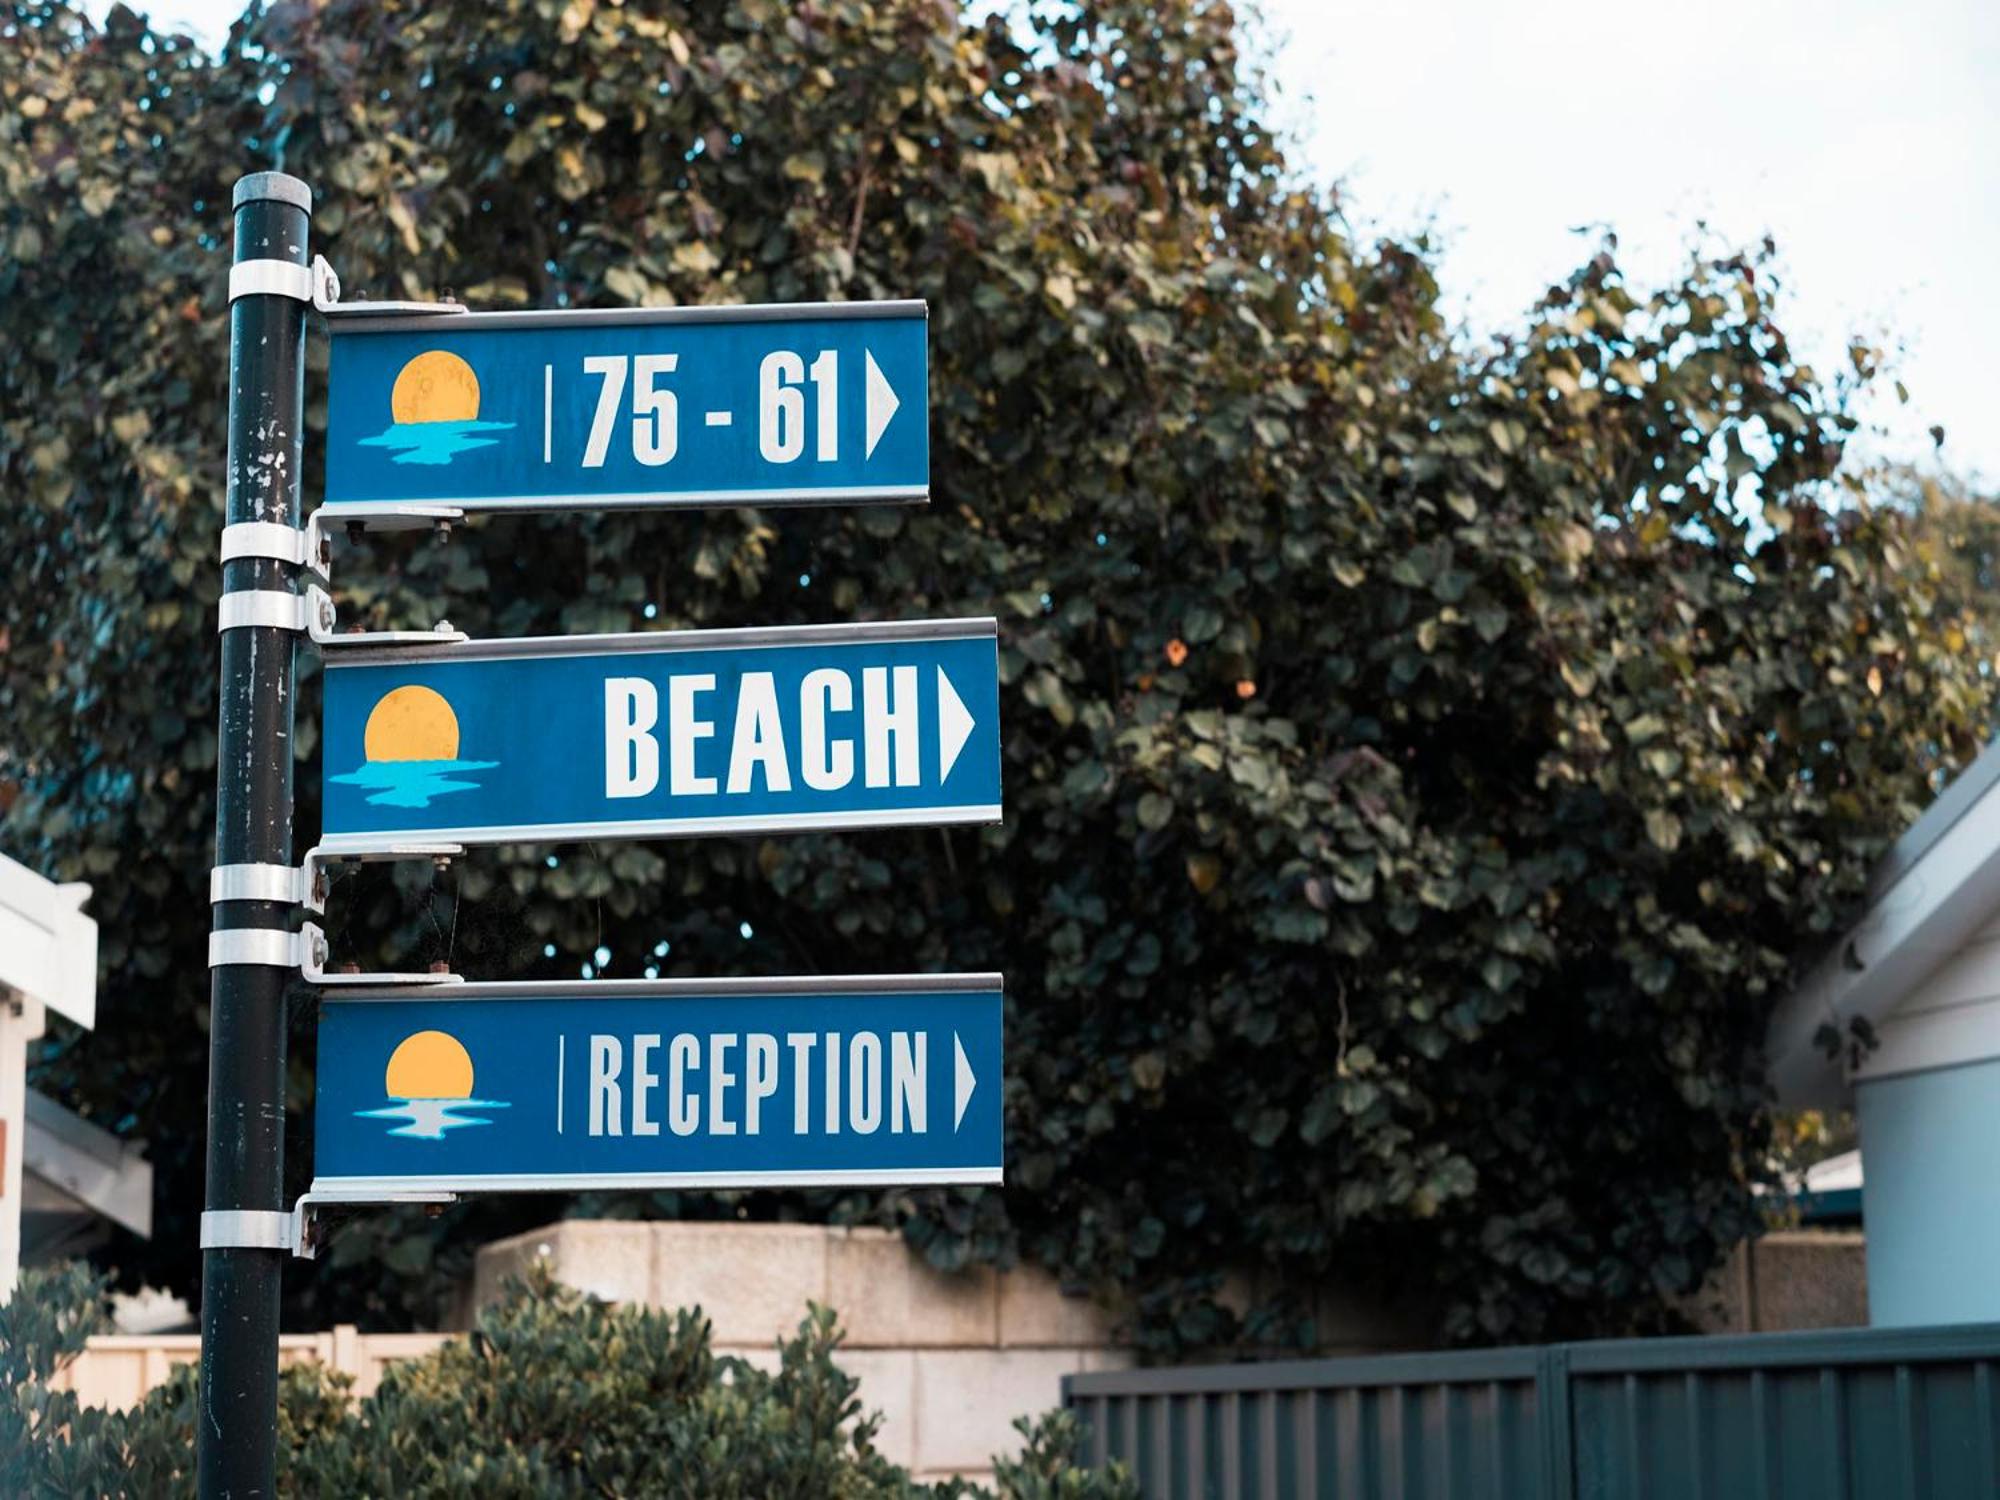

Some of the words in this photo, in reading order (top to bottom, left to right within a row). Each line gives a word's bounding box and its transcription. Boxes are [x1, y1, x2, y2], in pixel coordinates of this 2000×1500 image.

[582, 354, 678, 468] 75
[759, 350, 838, 463] 61
[604, 666, 920, 800] BEACH
[588, 1031, 928, 1137] RECEPTION
